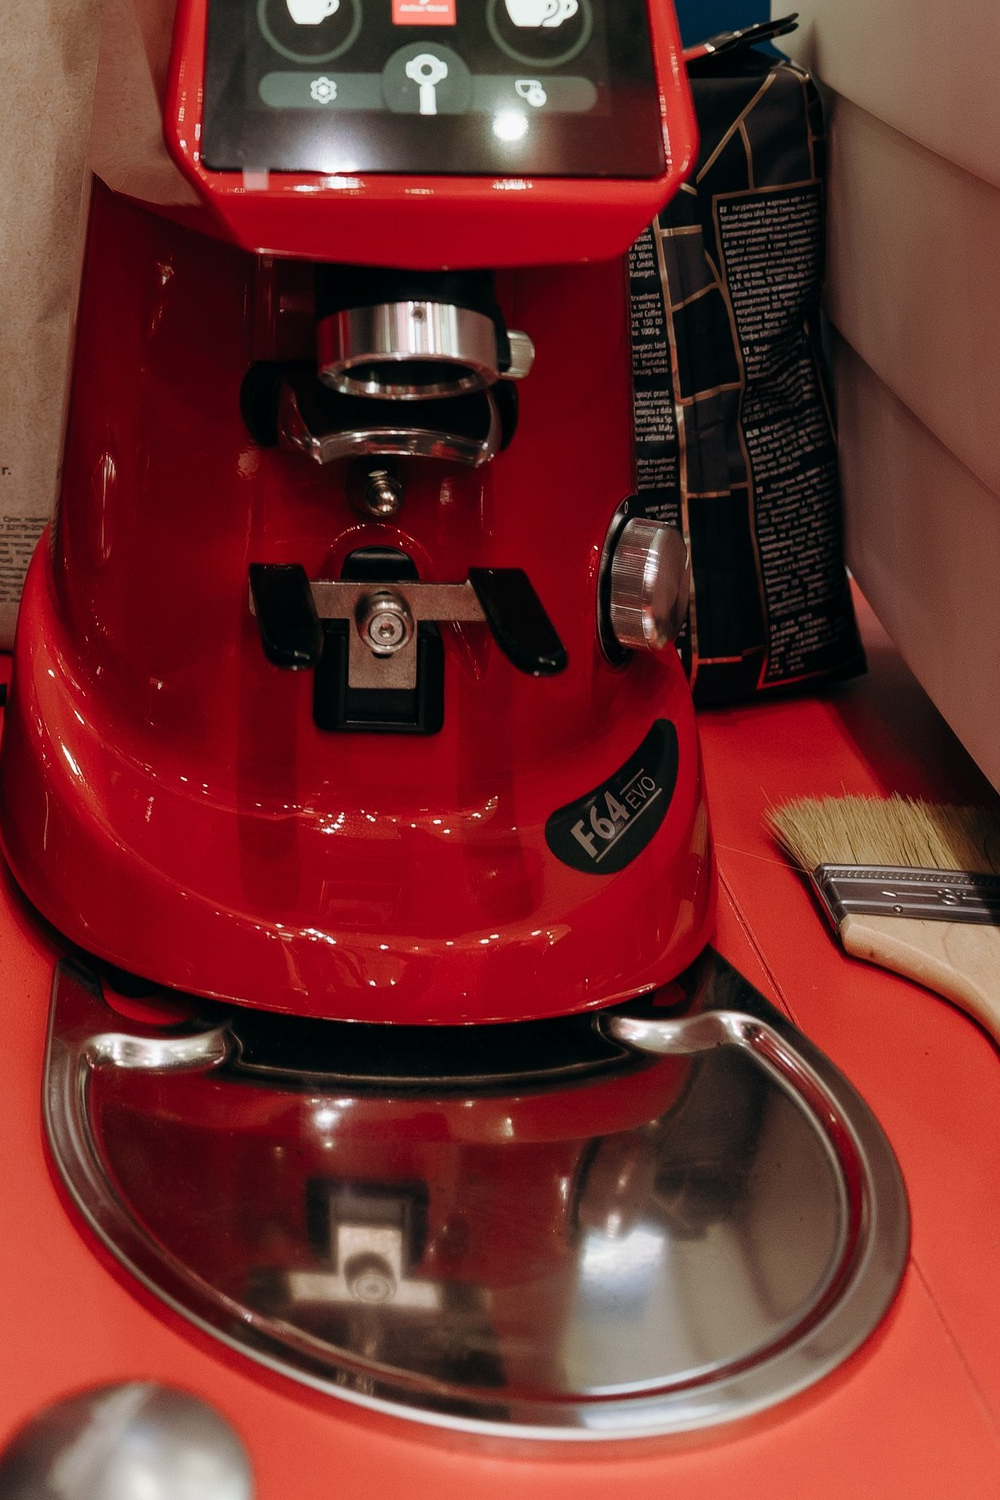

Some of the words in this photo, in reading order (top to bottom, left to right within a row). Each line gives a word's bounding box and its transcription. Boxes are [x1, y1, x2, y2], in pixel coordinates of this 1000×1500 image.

[1, 466, 12, 476] г.
[570, 790, 631, 859] F64
[624, 776, 657, 811] EVO
